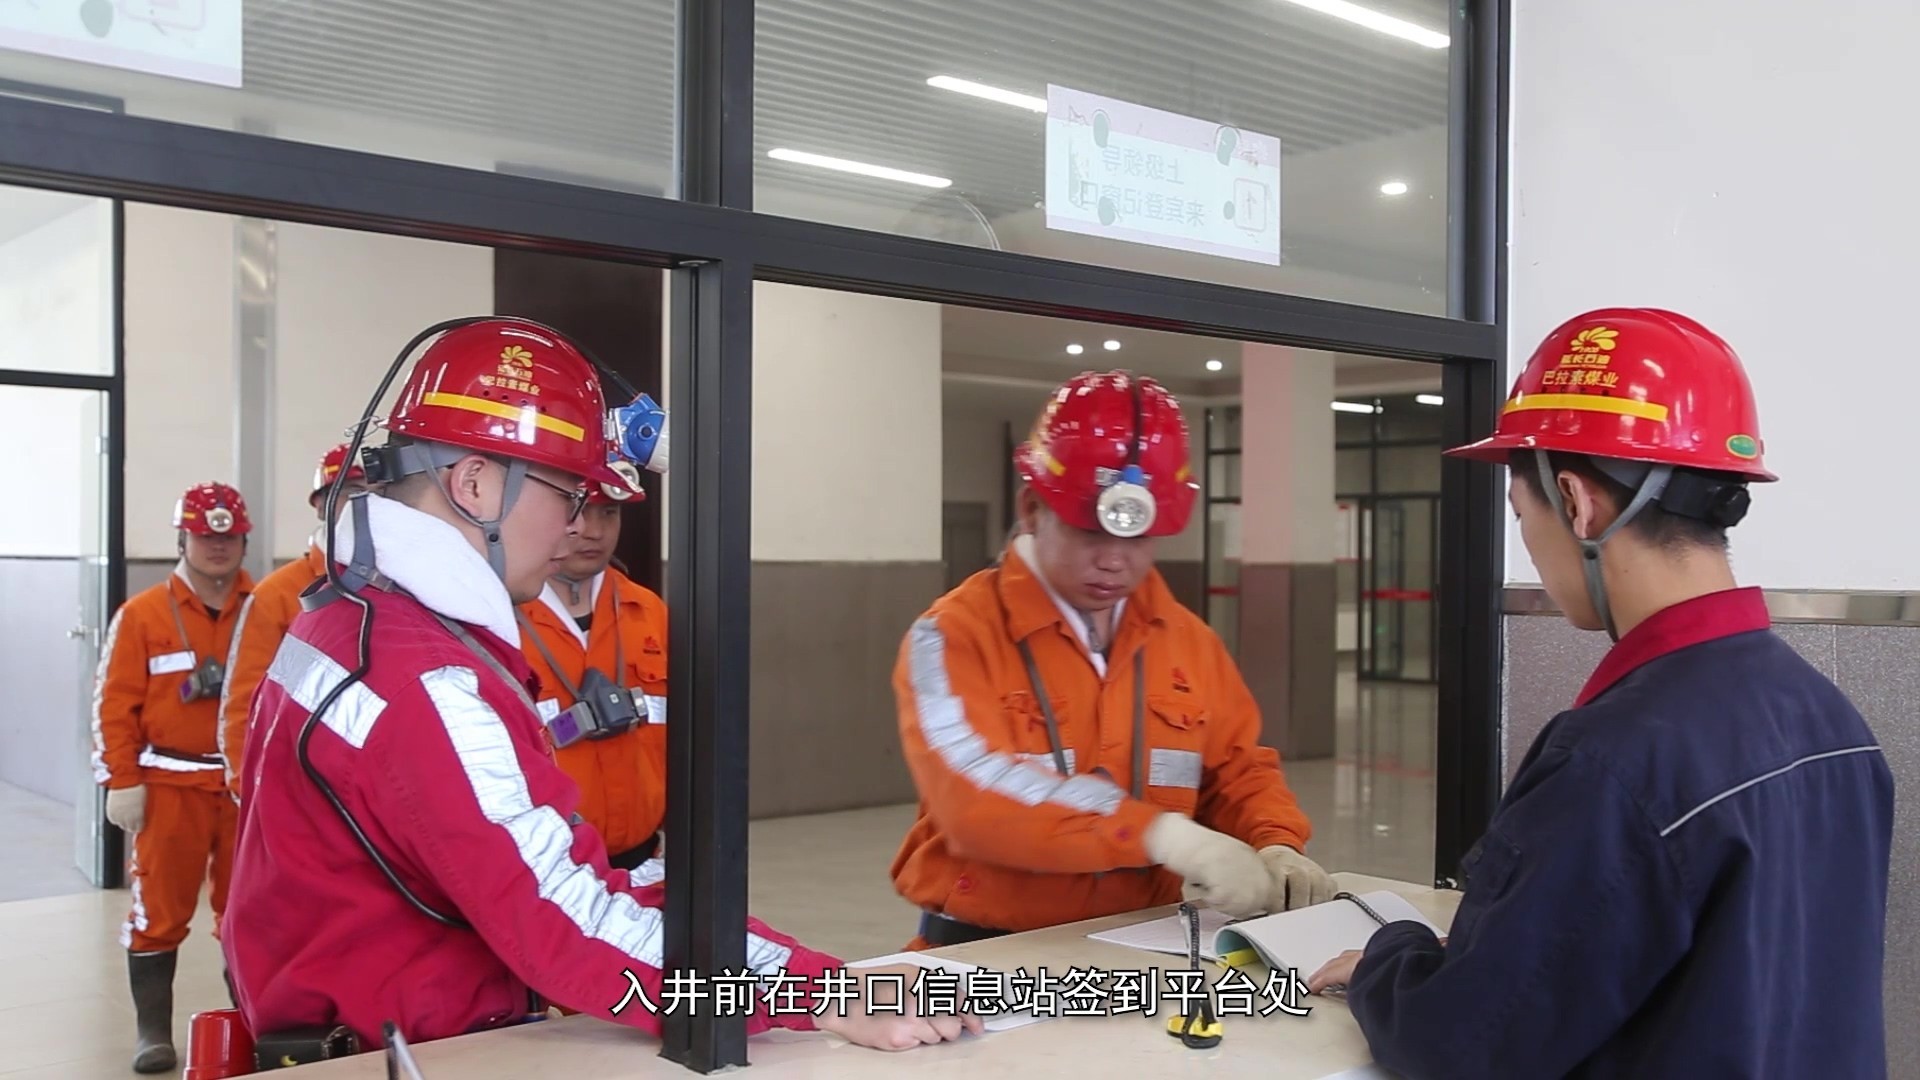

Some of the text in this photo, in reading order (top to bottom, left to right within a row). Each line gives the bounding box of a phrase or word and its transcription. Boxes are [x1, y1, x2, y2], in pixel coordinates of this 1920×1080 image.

[1542, 370, 1619, 388] 巴拉素煤业
